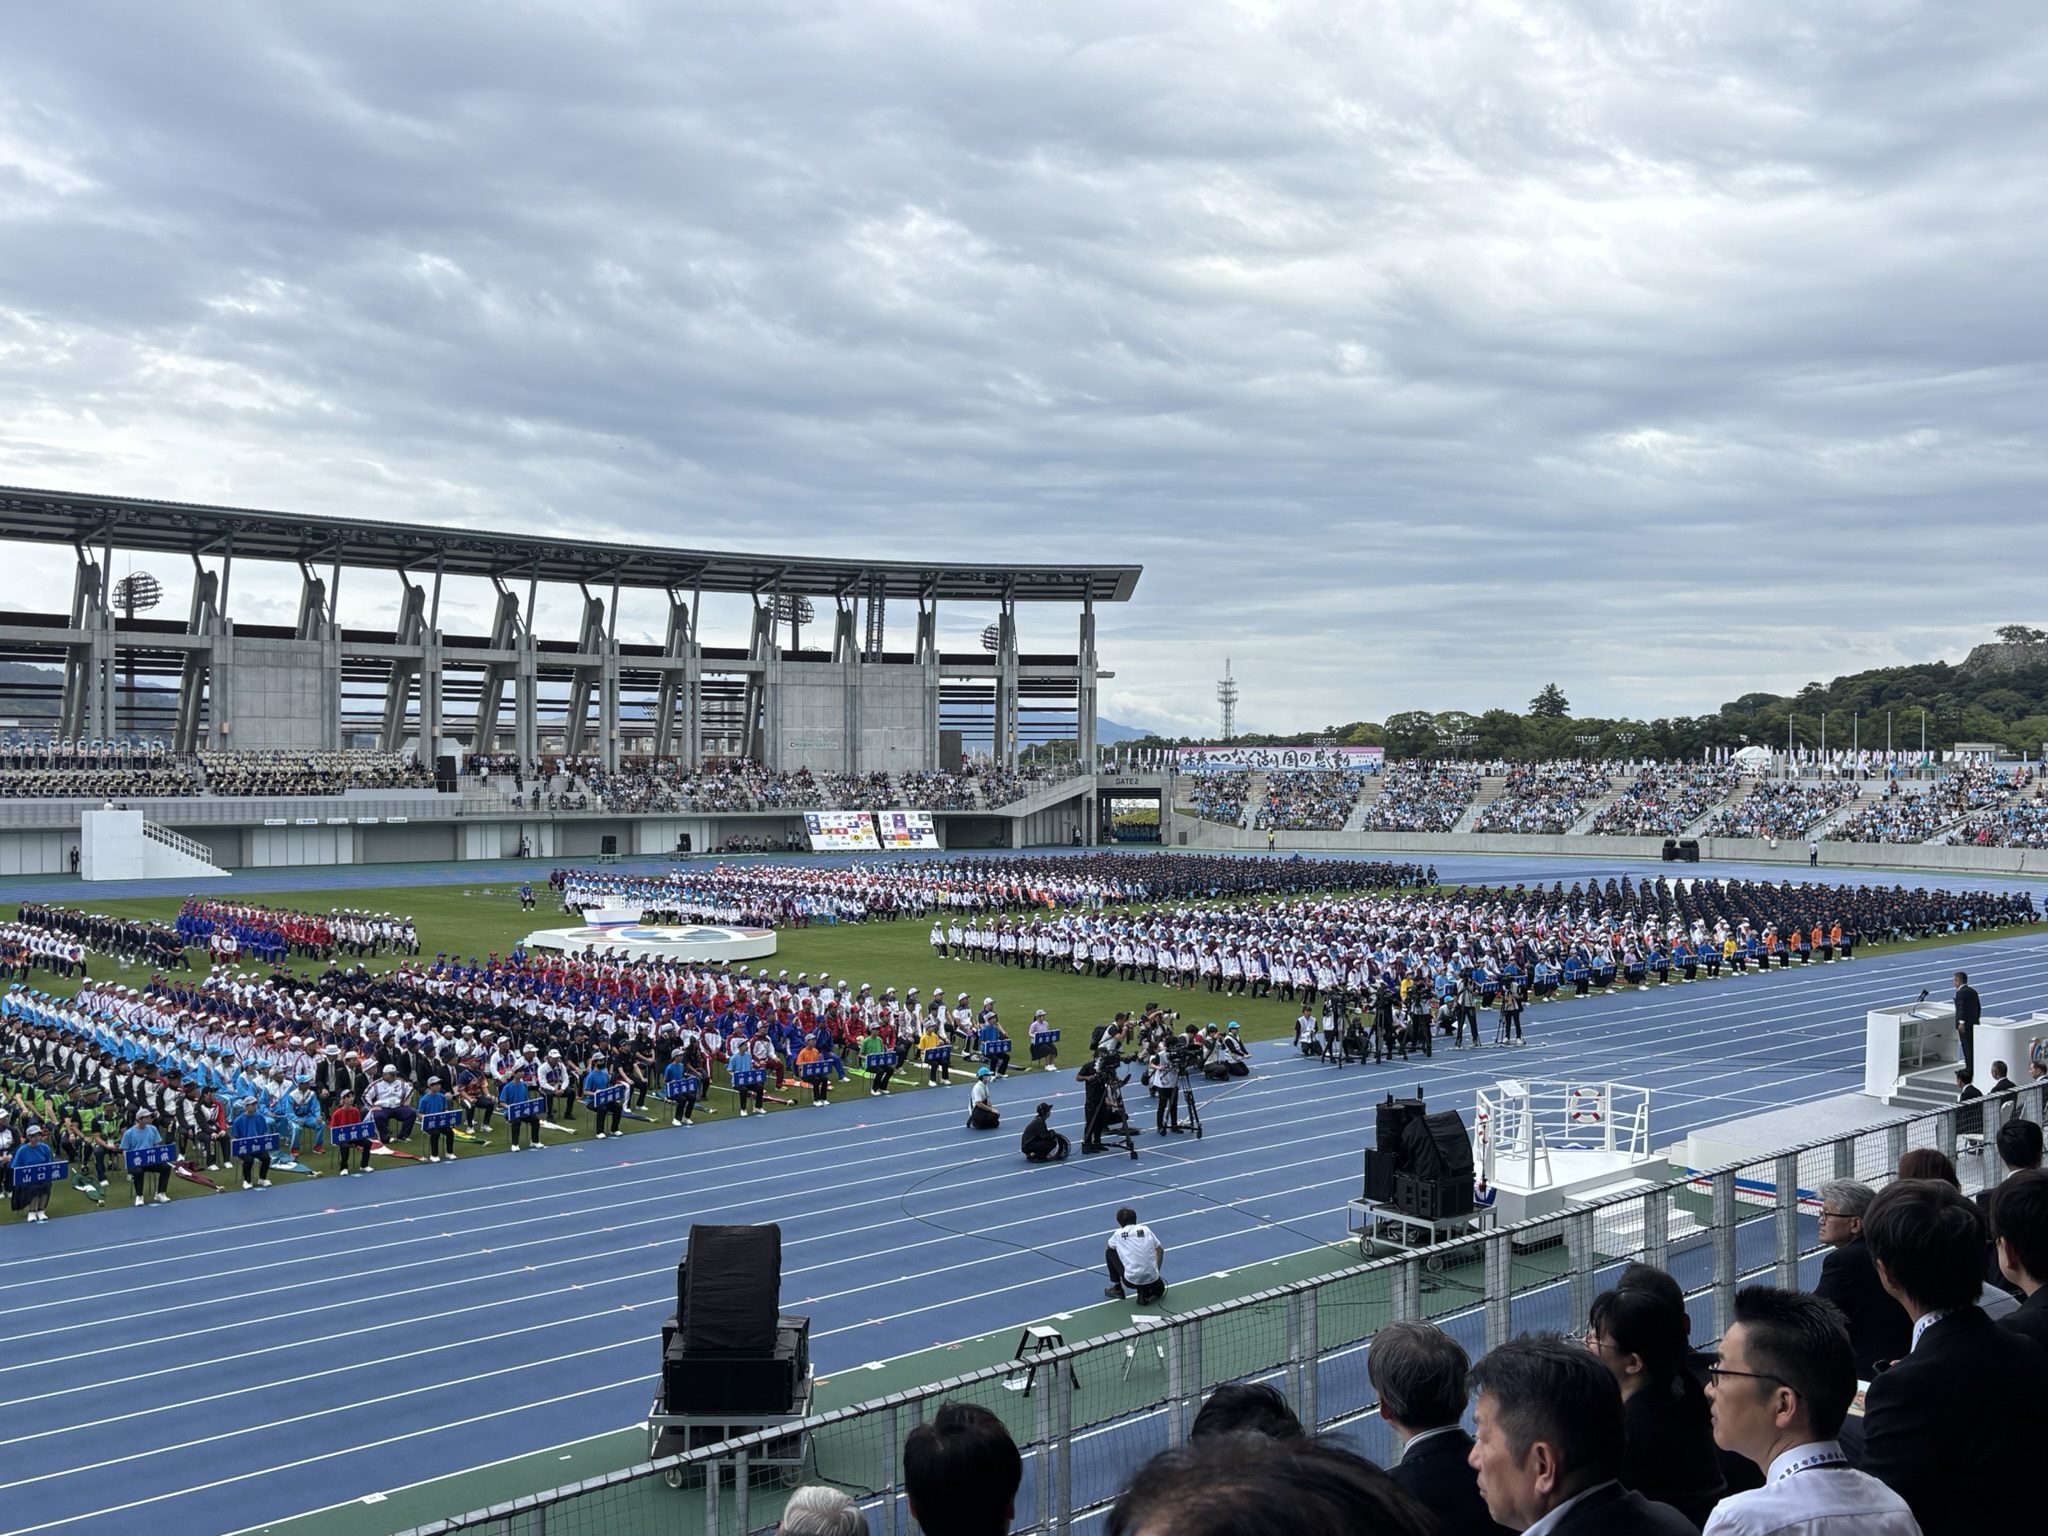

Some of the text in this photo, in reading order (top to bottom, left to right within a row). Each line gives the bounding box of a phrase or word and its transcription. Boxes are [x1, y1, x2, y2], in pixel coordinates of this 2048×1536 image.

[1115, 777, 1140, 785] GATE 2
[338, 1128, 369, 1142] 佐賀県
[238, 1141, 274, 1154] 高知県
[133, 1152, 171, 1166] 香川県
[22, 1169, 61, 1183] 山口県
